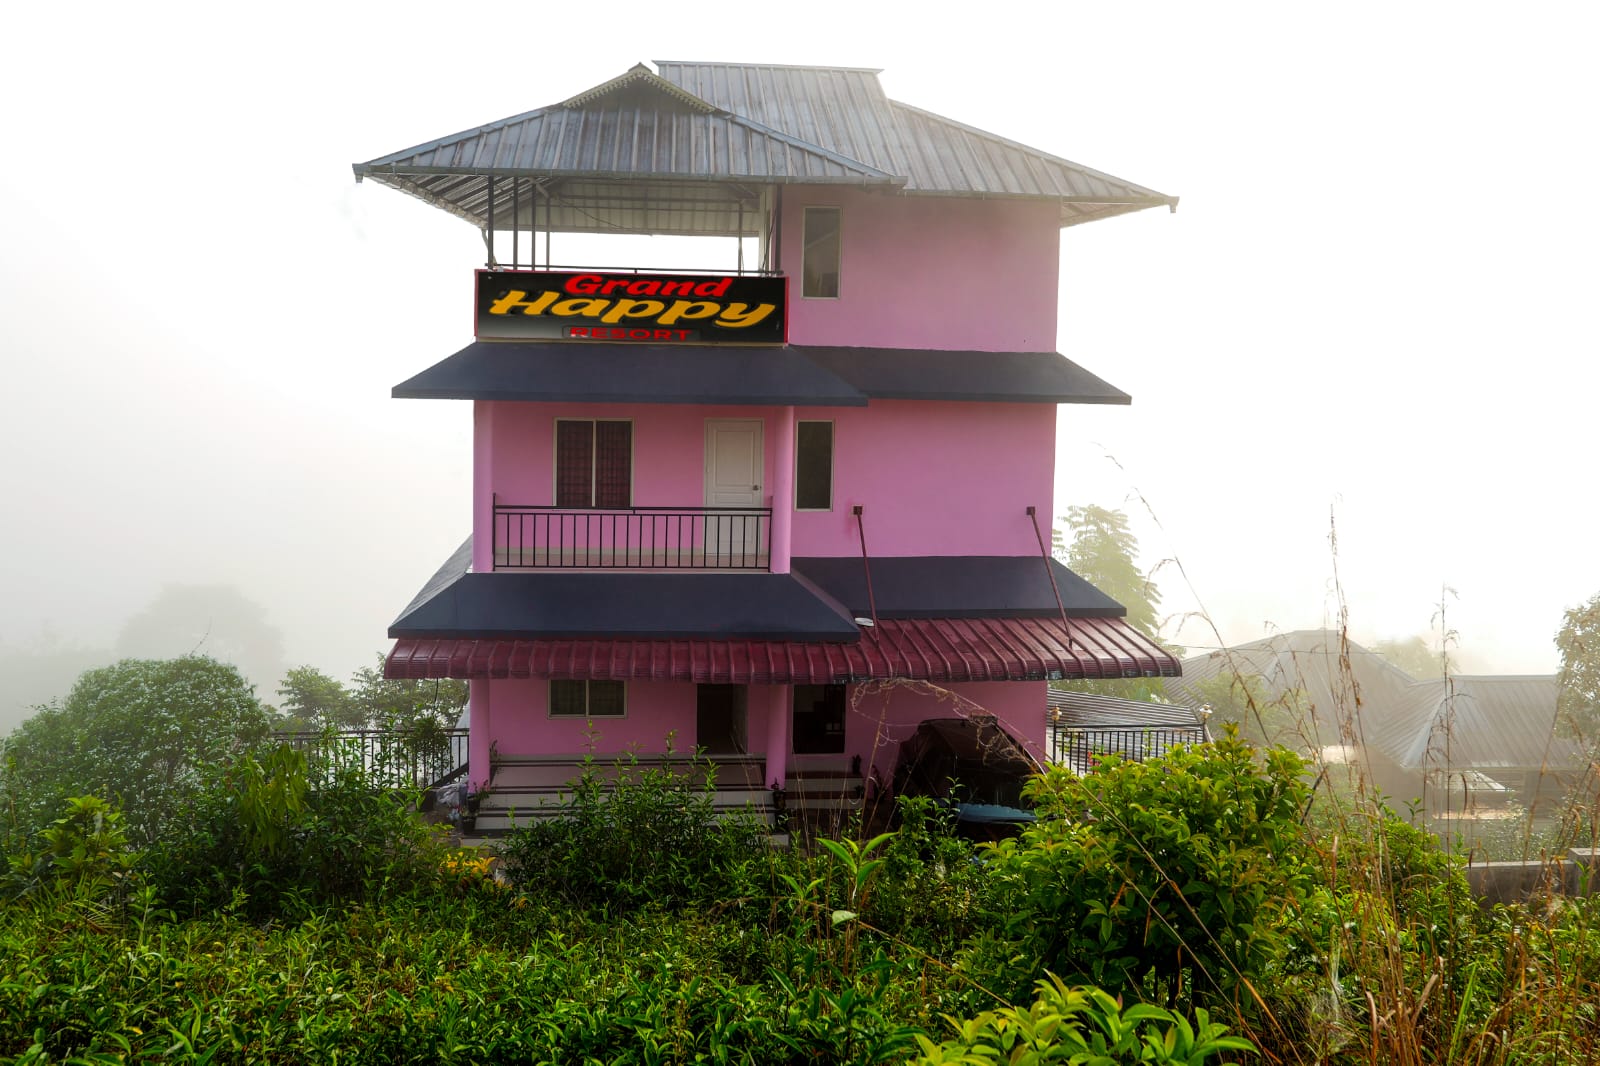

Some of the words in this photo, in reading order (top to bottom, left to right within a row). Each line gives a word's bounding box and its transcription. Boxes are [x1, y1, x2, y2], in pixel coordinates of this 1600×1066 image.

[565, 274, 732, 297] Grand
[489, 290, 776, 328] Happy
[569, 327, 692, 341] RESORT
